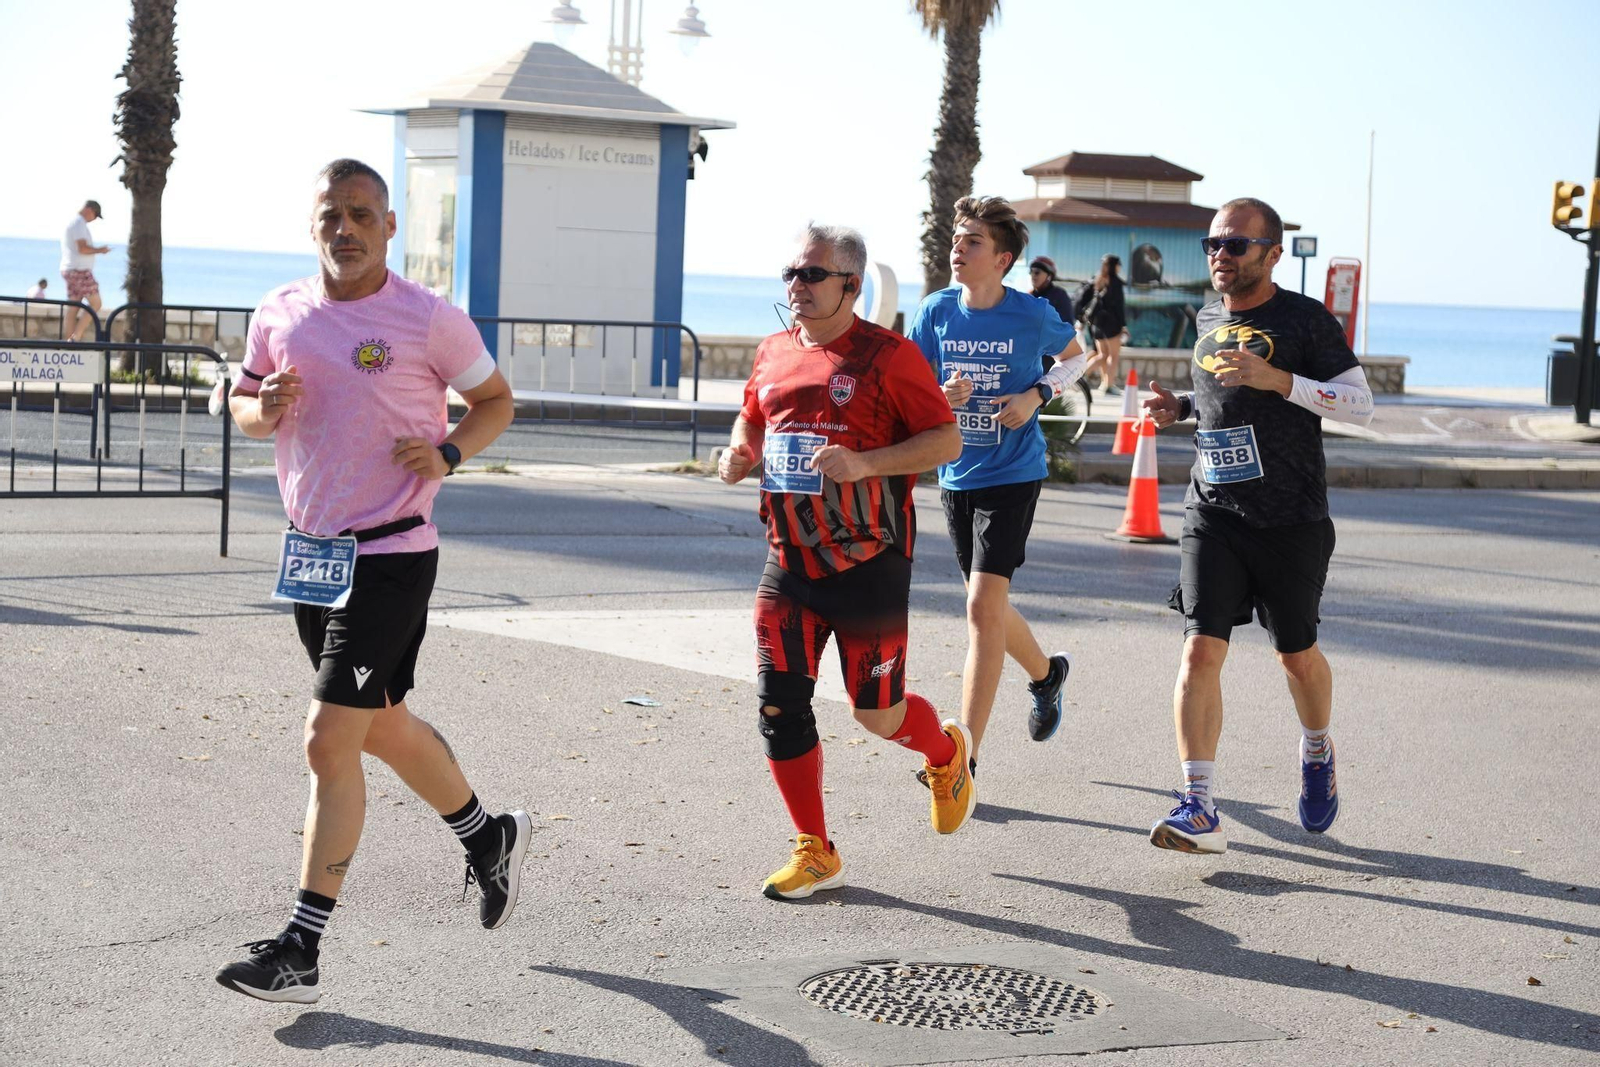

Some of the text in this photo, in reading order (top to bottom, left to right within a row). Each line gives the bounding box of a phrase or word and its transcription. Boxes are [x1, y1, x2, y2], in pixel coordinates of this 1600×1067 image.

[508, 139, 566, 160] Helados
[578, 144, 600, 162] Ice
[603, 146, 656, 166] Creams
[941, 338, 1014, 356] mayoral
[44, 353, 85, 366] LOCAL
[819, 421, 849, 432] Málaga
[1203, 447, 1250, 467] 1868
[288, 558, 345, 582] 2118
